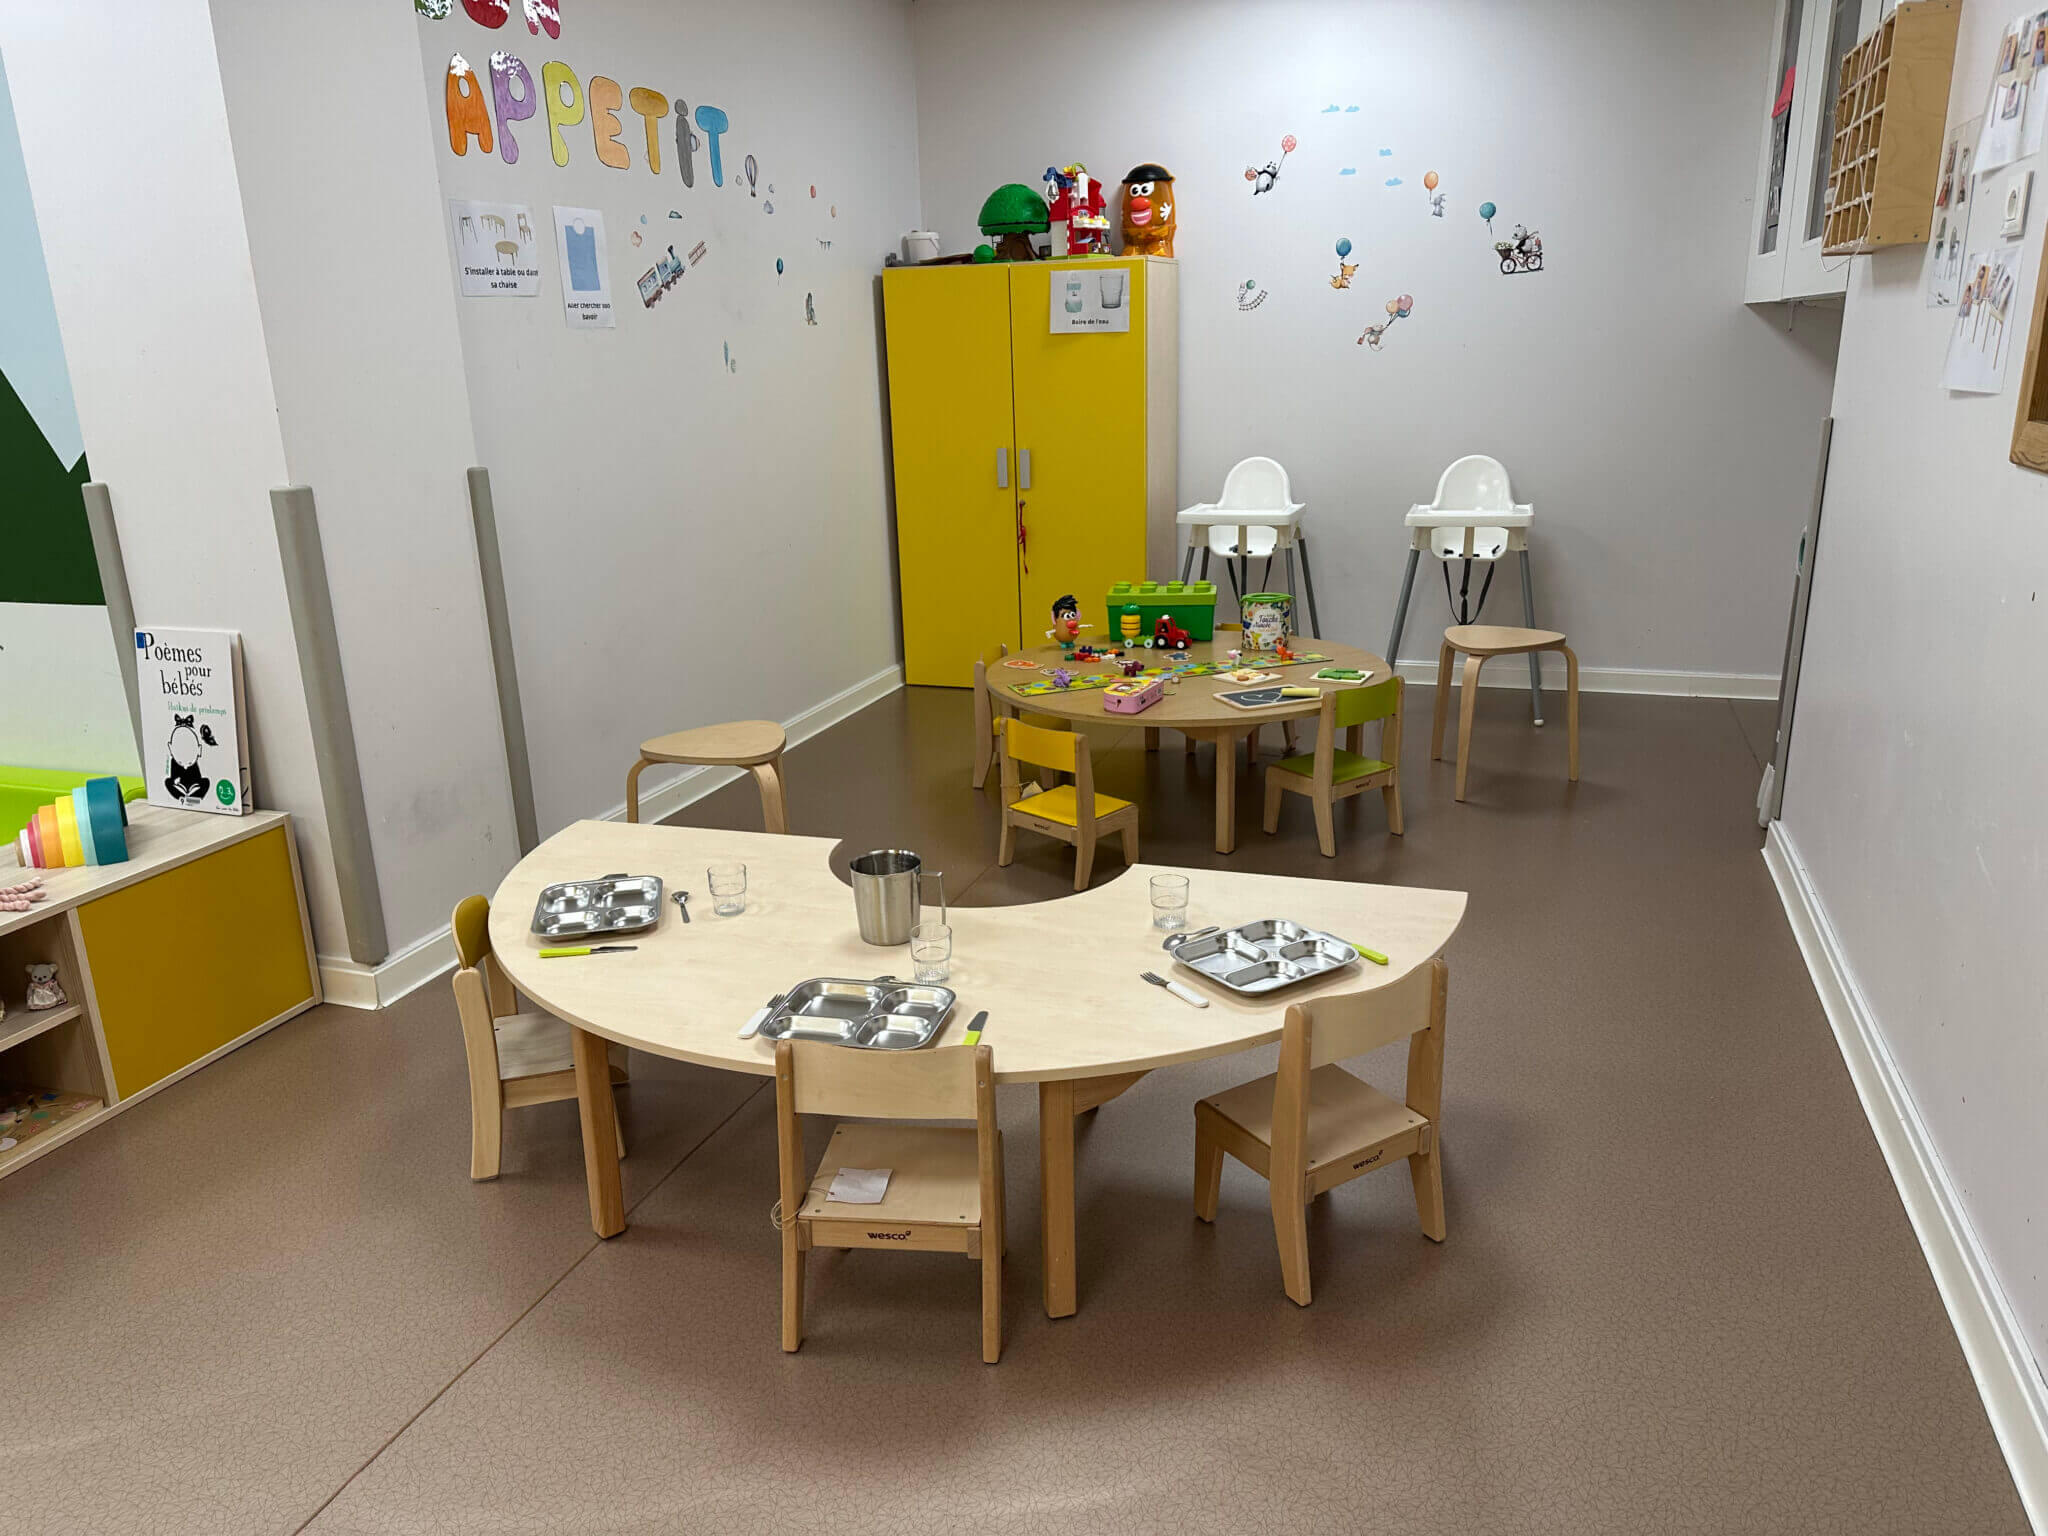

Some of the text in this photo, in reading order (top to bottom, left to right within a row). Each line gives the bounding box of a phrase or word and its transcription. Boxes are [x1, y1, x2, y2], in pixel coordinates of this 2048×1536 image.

[500, 268, 516, 276] table
[143, 632, 202, 663] Poèmes
[184, 666, 212, 681] pour
[160, 669, 203, 697] bébés
[1353, 1153, 1381, 1169] wesco
[867, 1231, 908, 1240] wesco
